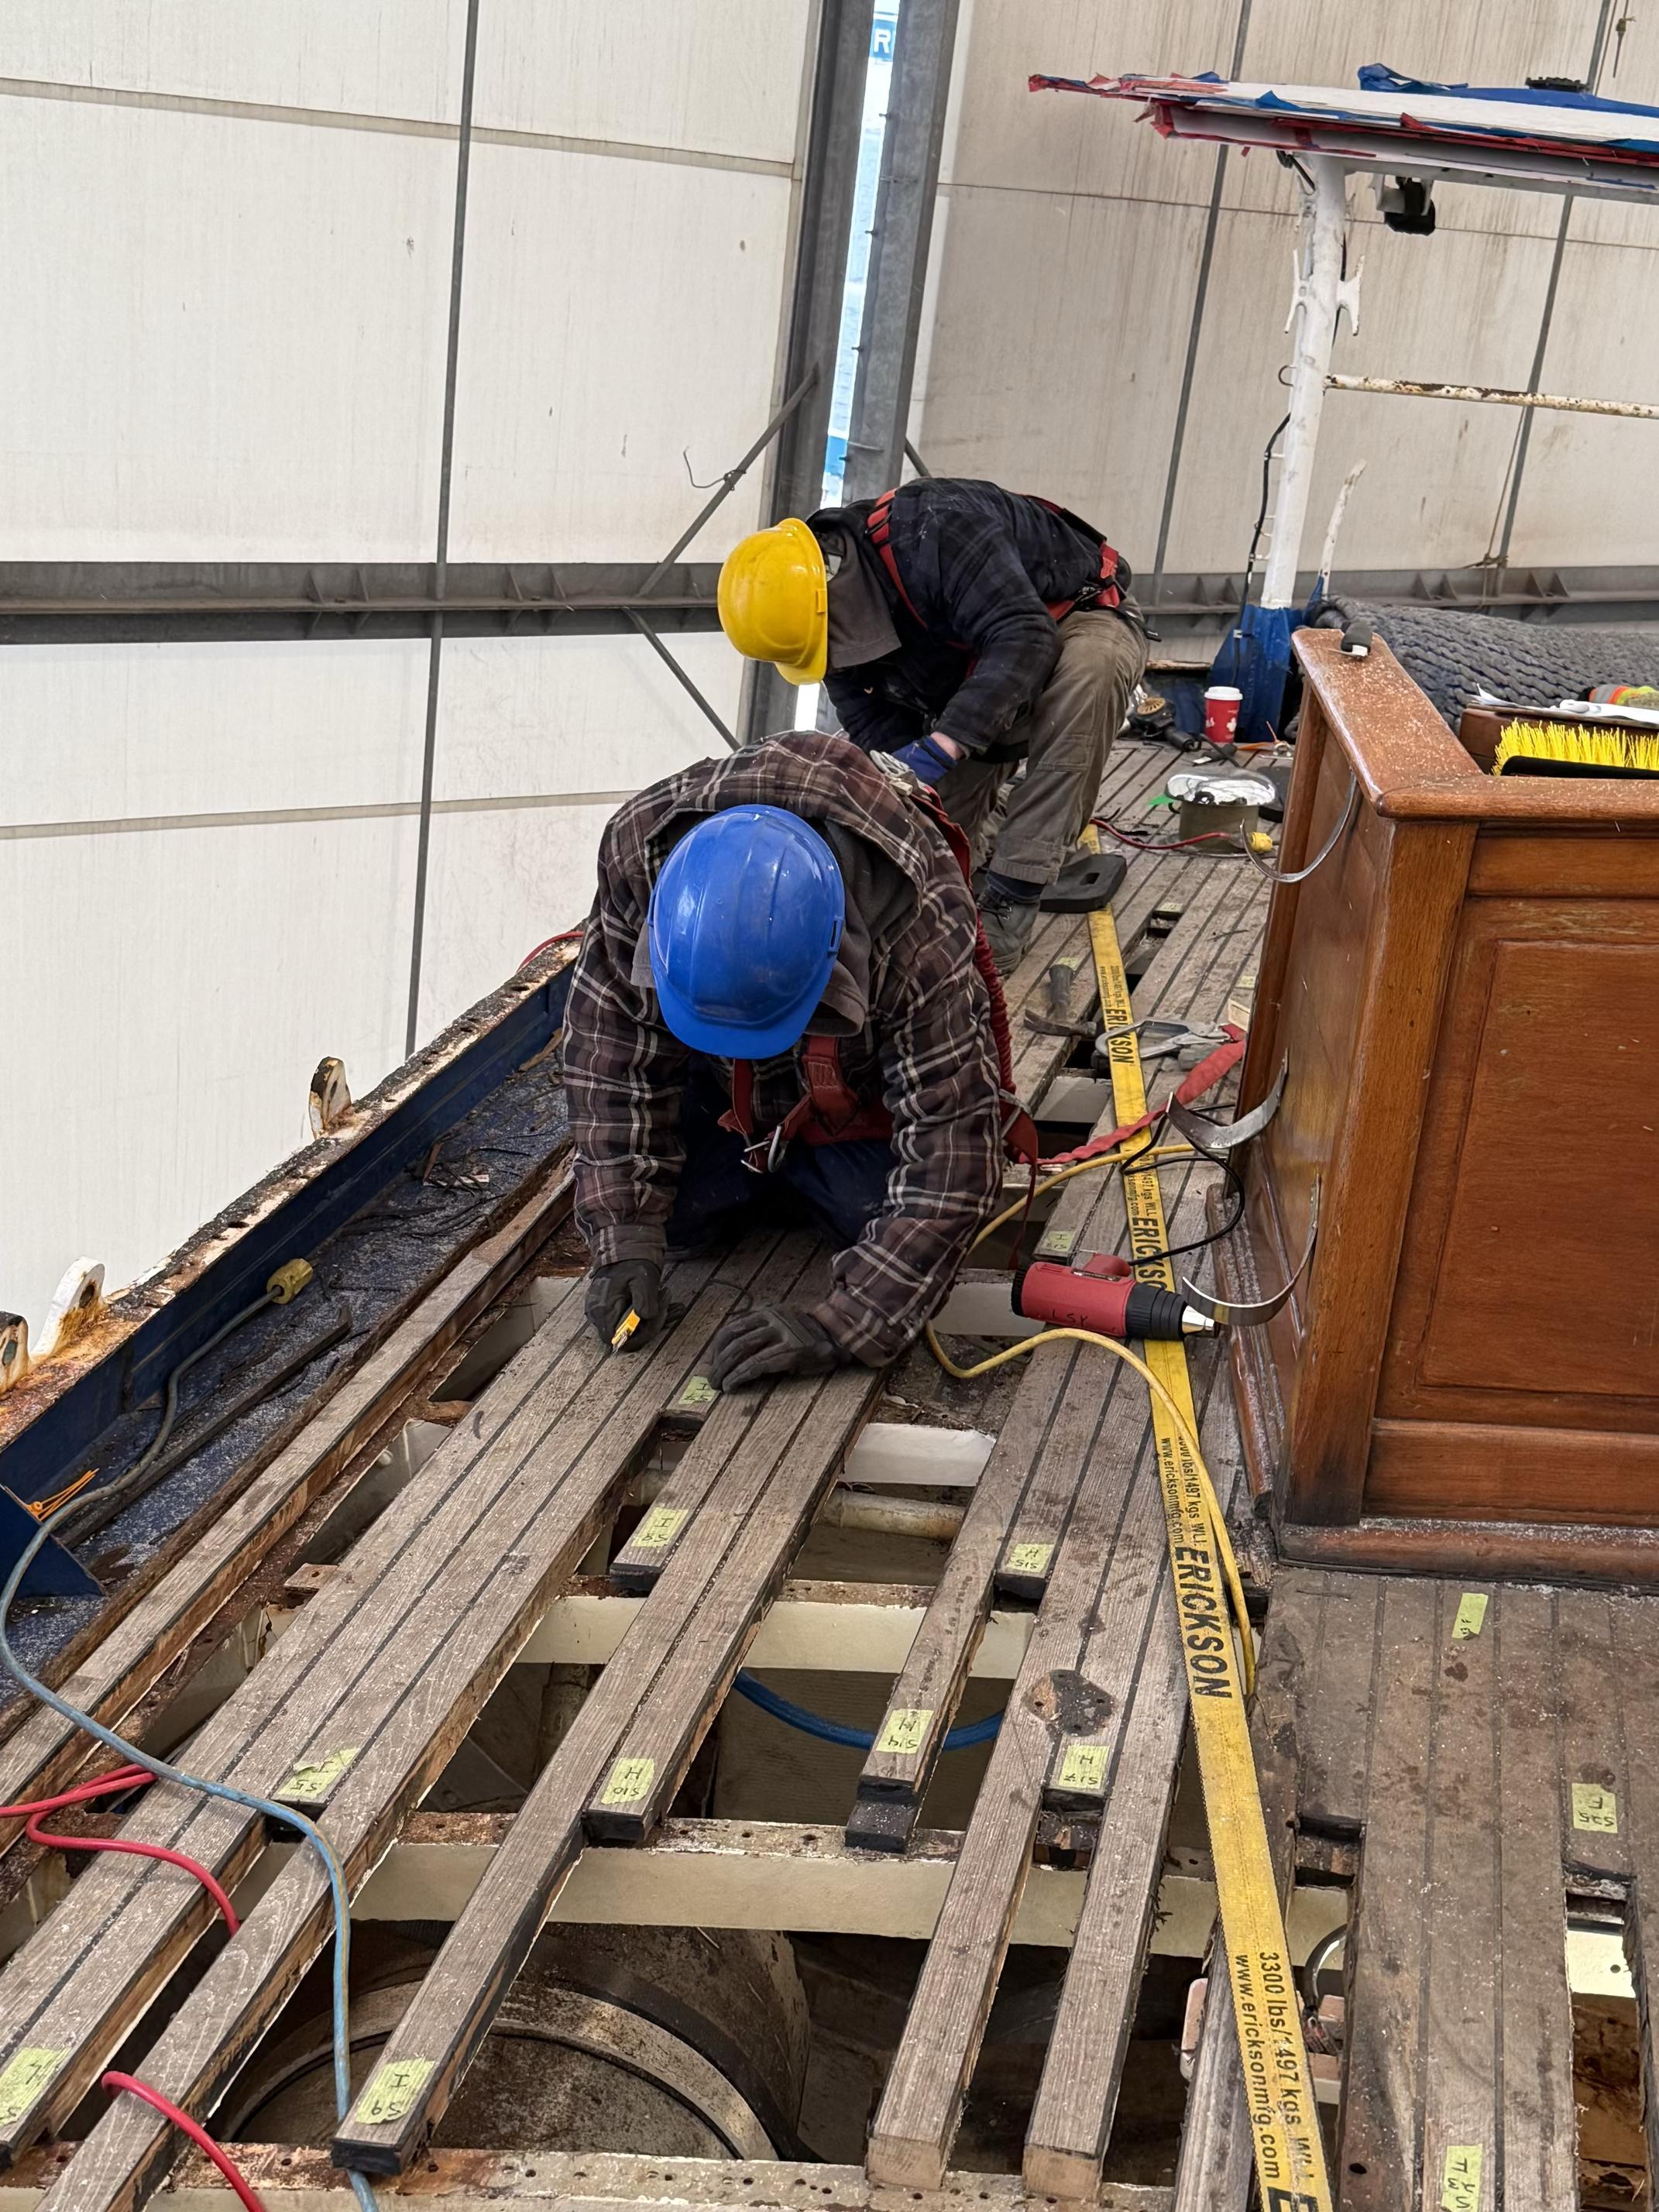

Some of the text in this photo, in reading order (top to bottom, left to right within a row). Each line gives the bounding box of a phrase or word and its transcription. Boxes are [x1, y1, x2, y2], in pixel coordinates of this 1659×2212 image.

[874, 29, 891, 53] R
[1145, 1202, 1157, 1217] WLL
[1161, 1437, 1184, 1544] www.ericksonmfg.com
[1185, 1501, 1201, 1519] kgs
[641, 1533, 668, 1542] S8
[1175, 1547, 1232, 1698] ERICKSON
[622, 1767, 639, 1780] H
[1588, 1797, 1603, 1809] F
[1578, 1812, 1614, 1826] S25
[1259, 1953, 1285, 1999] 3300
[1268, 1999, 1300, 2082] lbs/1497
[1235, 1954, 1280, 2179] www.ericksonmfg.com
[373, 2102, 400, 2117] S9
[1448, 2158, 1468, 2173] F
